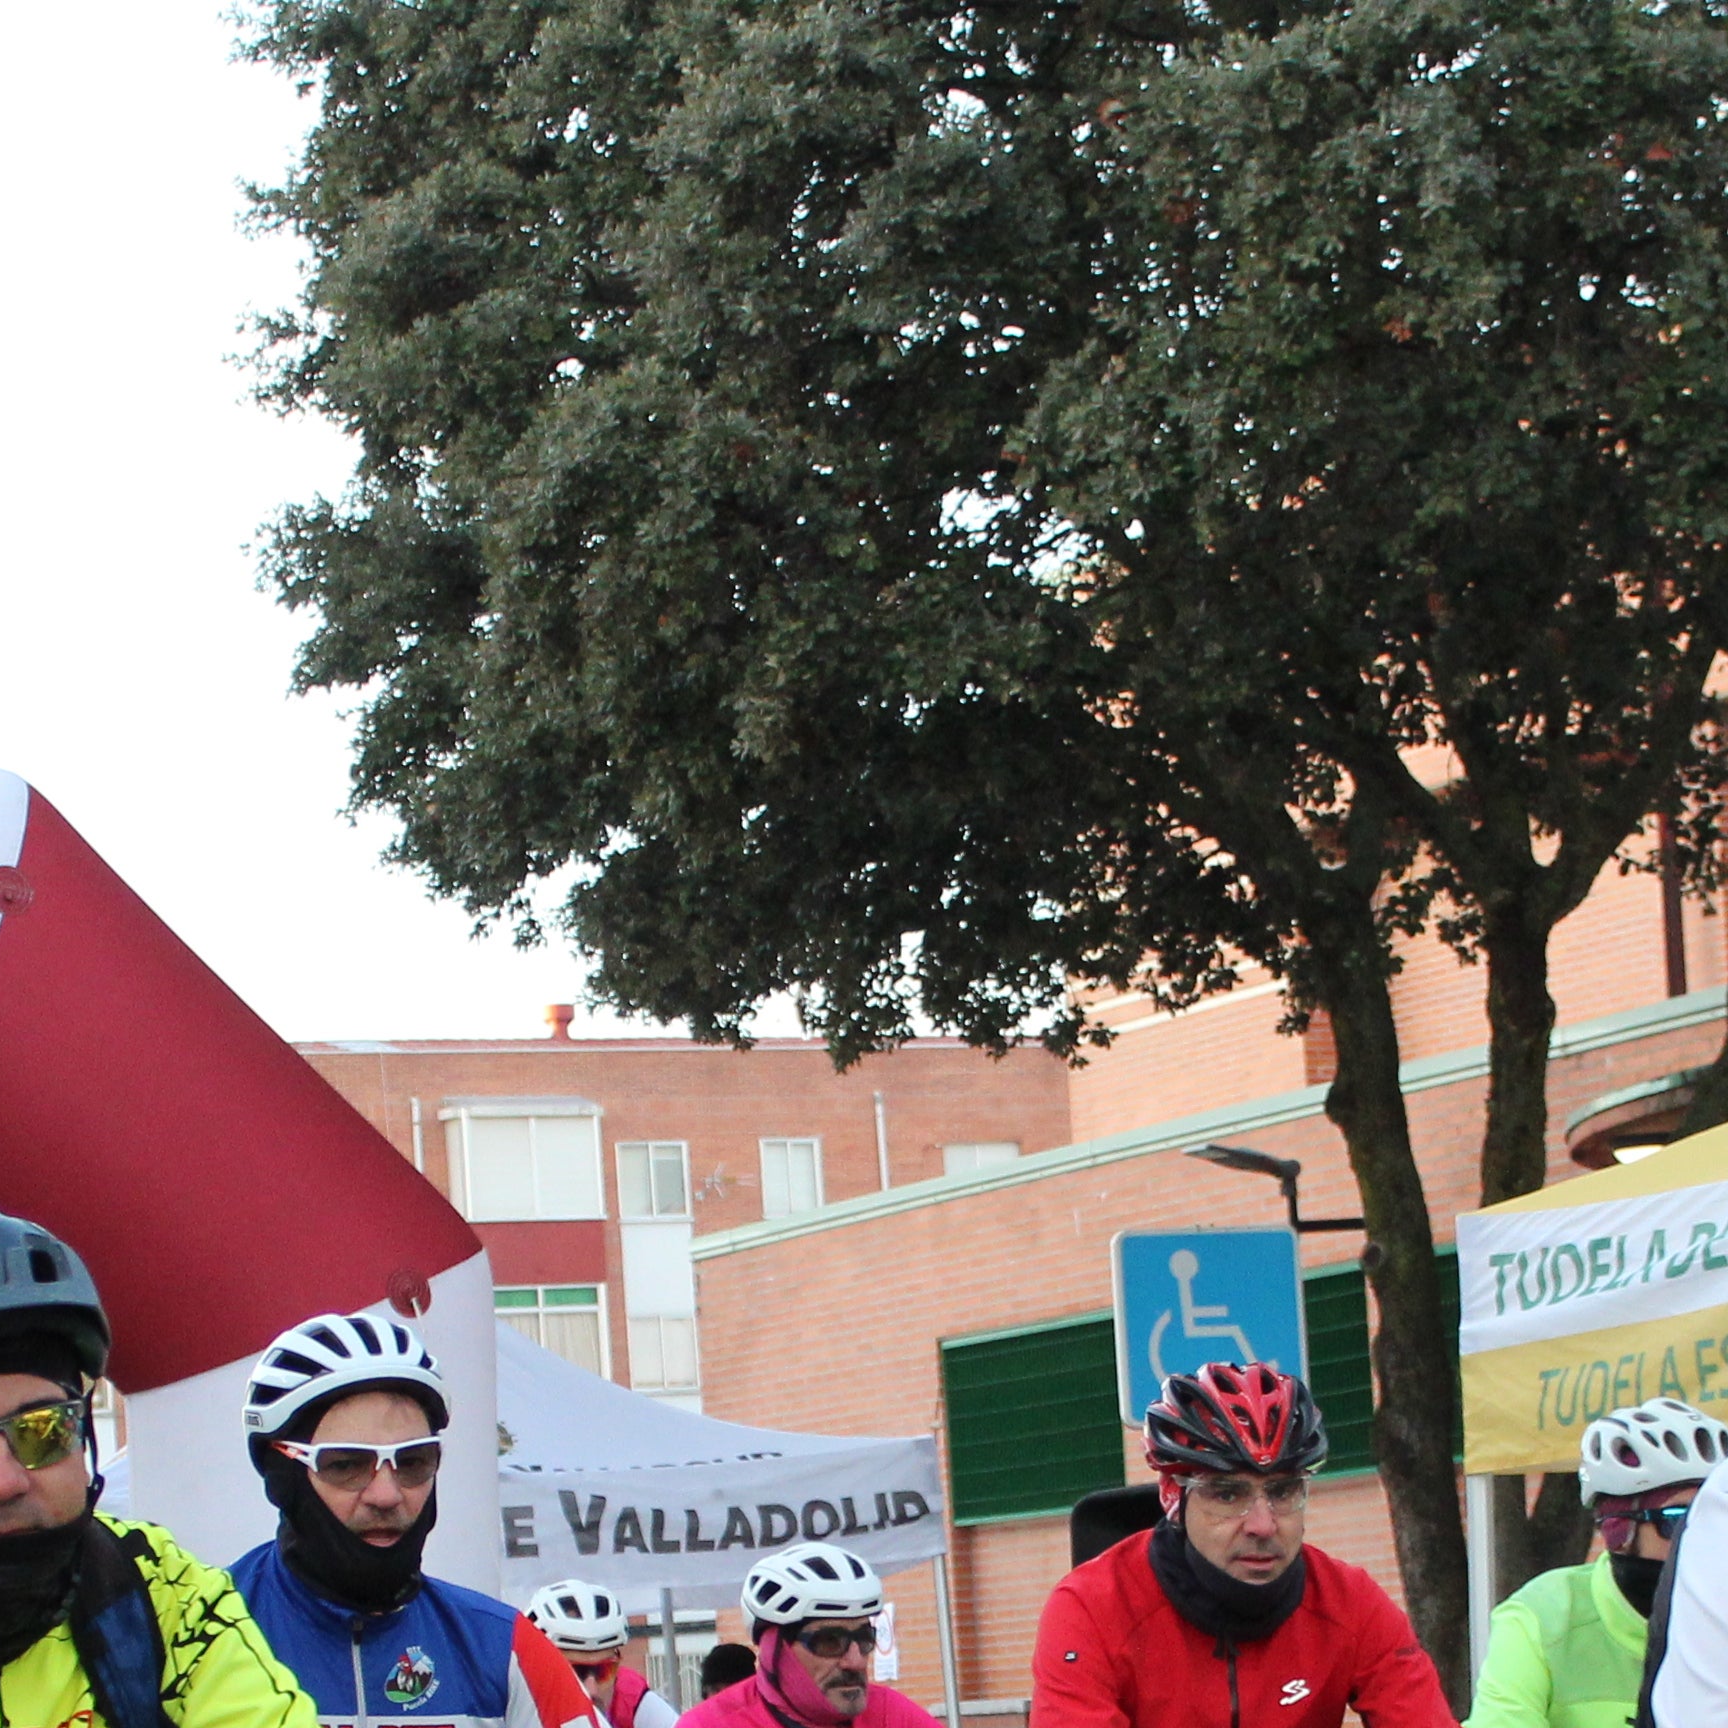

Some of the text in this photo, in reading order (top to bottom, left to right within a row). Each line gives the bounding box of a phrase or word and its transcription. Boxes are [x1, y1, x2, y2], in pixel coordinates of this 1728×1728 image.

[1489, 1229, 1666, 1316] TUDELA
[1537, 1346, 1688, 1430] TUDELA
[558, 1489, 931, 1556] VALLADOLID
